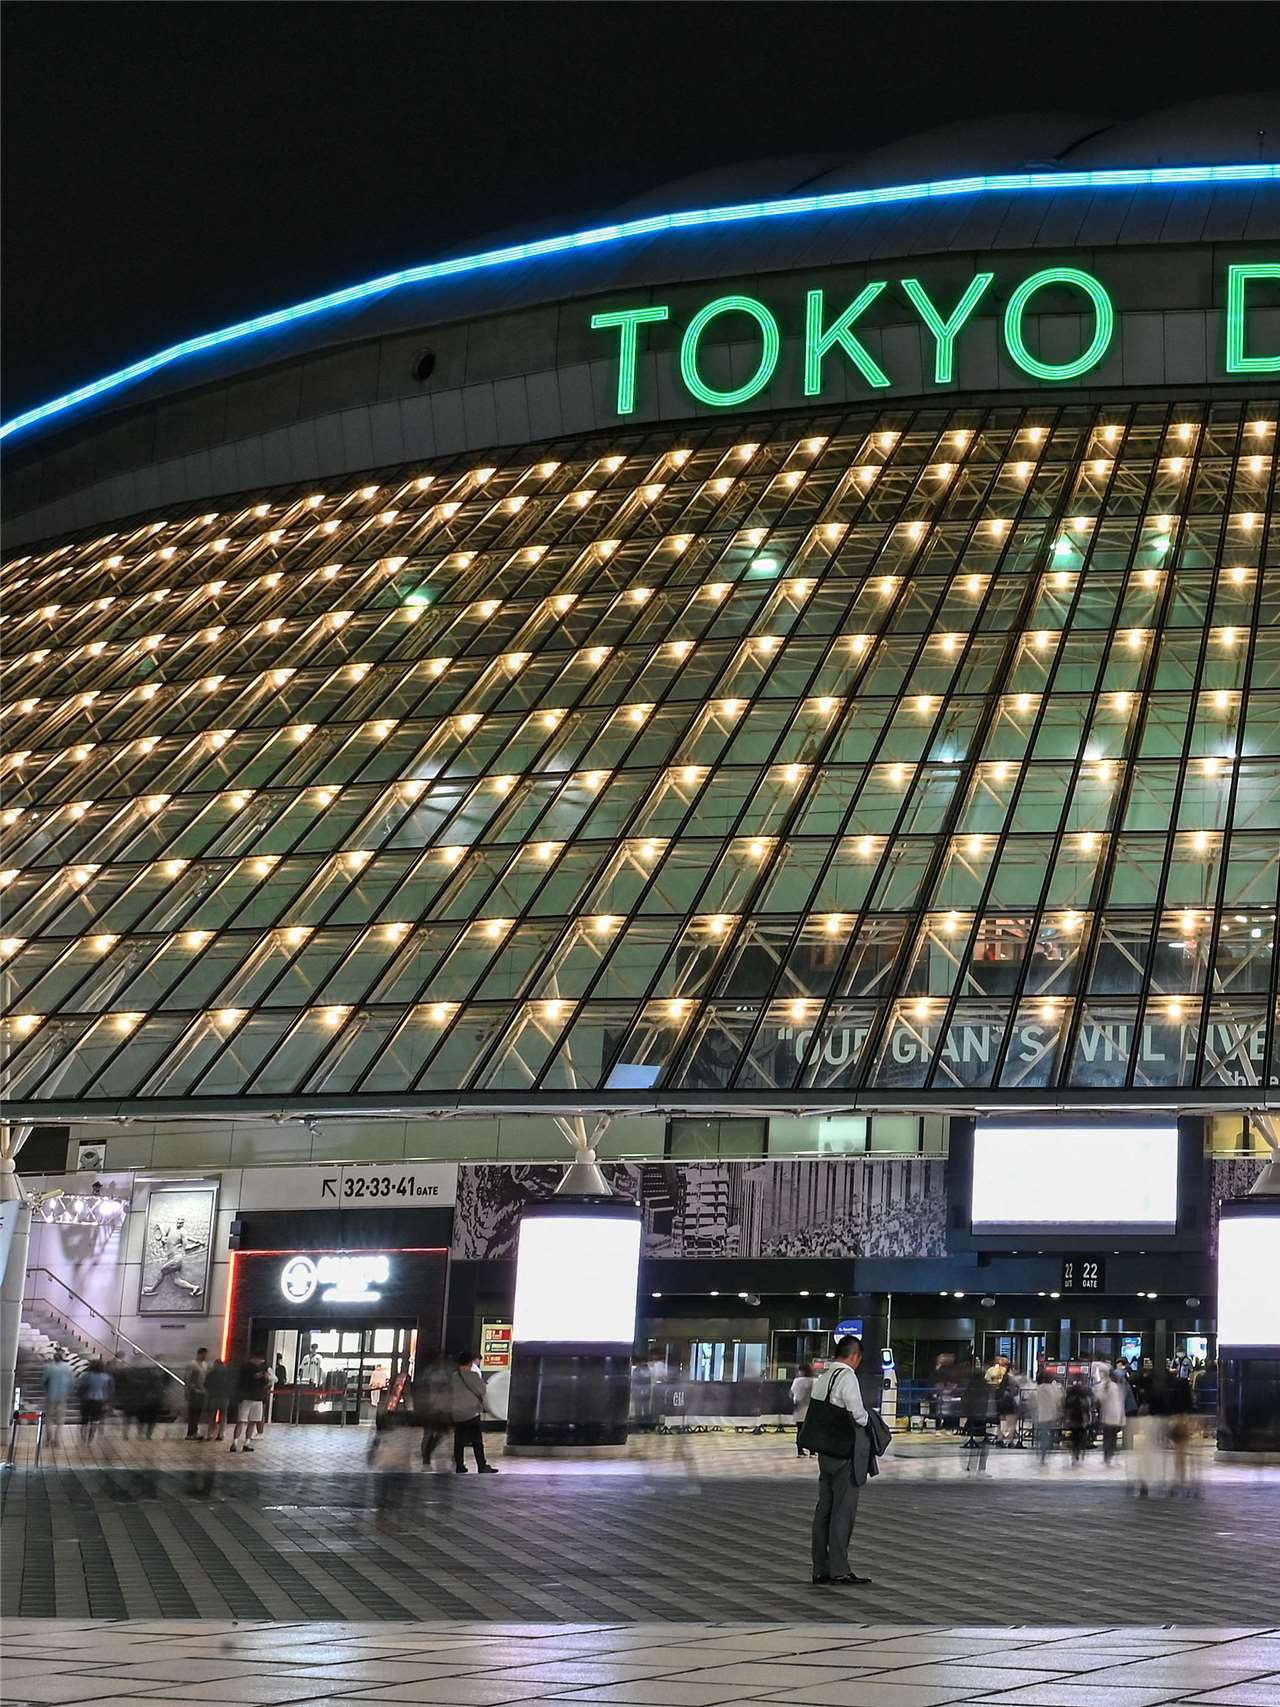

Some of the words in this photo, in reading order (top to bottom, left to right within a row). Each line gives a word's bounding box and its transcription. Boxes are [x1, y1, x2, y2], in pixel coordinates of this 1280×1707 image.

[590, 266, 1114, 415] TOKYO
[416, 1186, 439, 1196] GATE
[1083, 1262, 1098, 1279] 22
[1082, 1279, 1098, 1288] GATE
